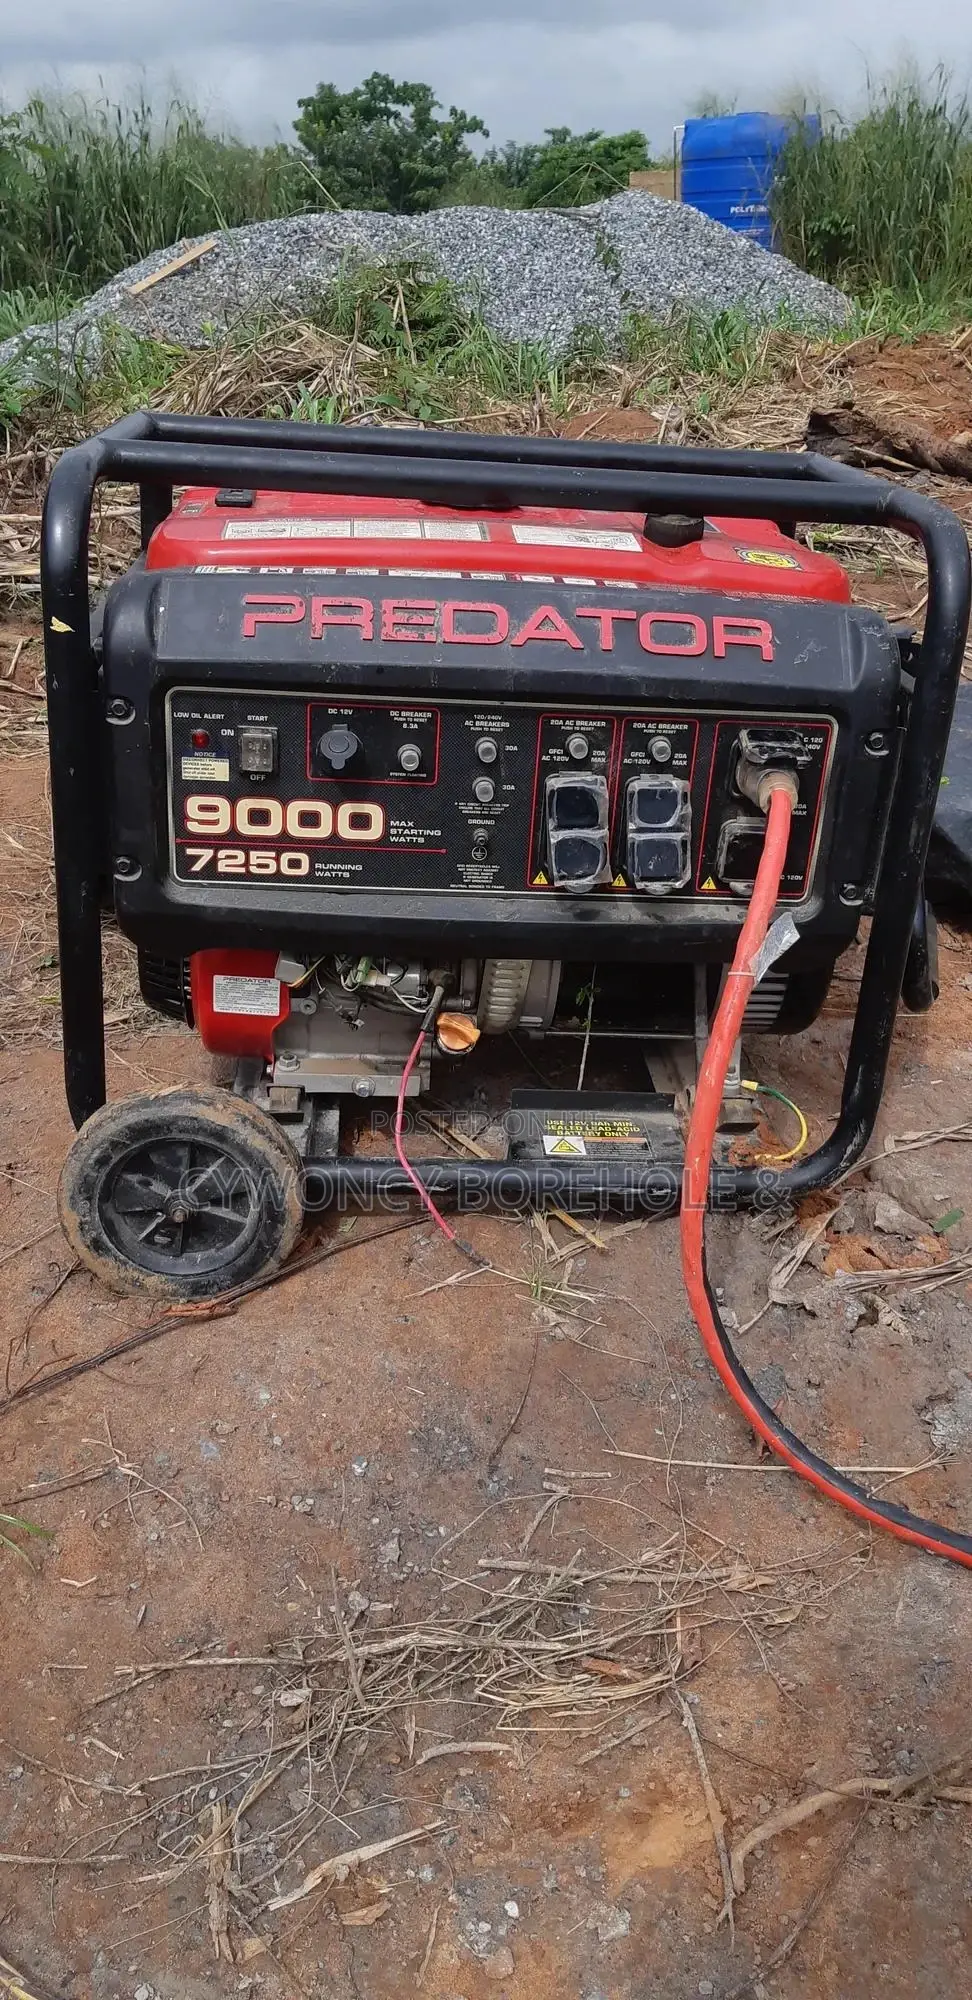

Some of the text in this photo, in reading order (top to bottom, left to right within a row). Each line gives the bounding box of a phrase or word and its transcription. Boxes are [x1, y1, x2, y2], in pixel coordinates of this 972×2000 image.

[241, 594, 774, 662] PREDATOR
[221, 729, 235, 737] ON
[185, 795, 384, 841] 9000
[390, 820, 414, 828] MAX
[390, 828, 441, 836] STARTING
[390, 836, 425, 844] WATTS
[186, 848, 310, 876] 7250
[315, 863, 363, 871] RUNNING
[223, 976, 271, 984] PREDATOR
